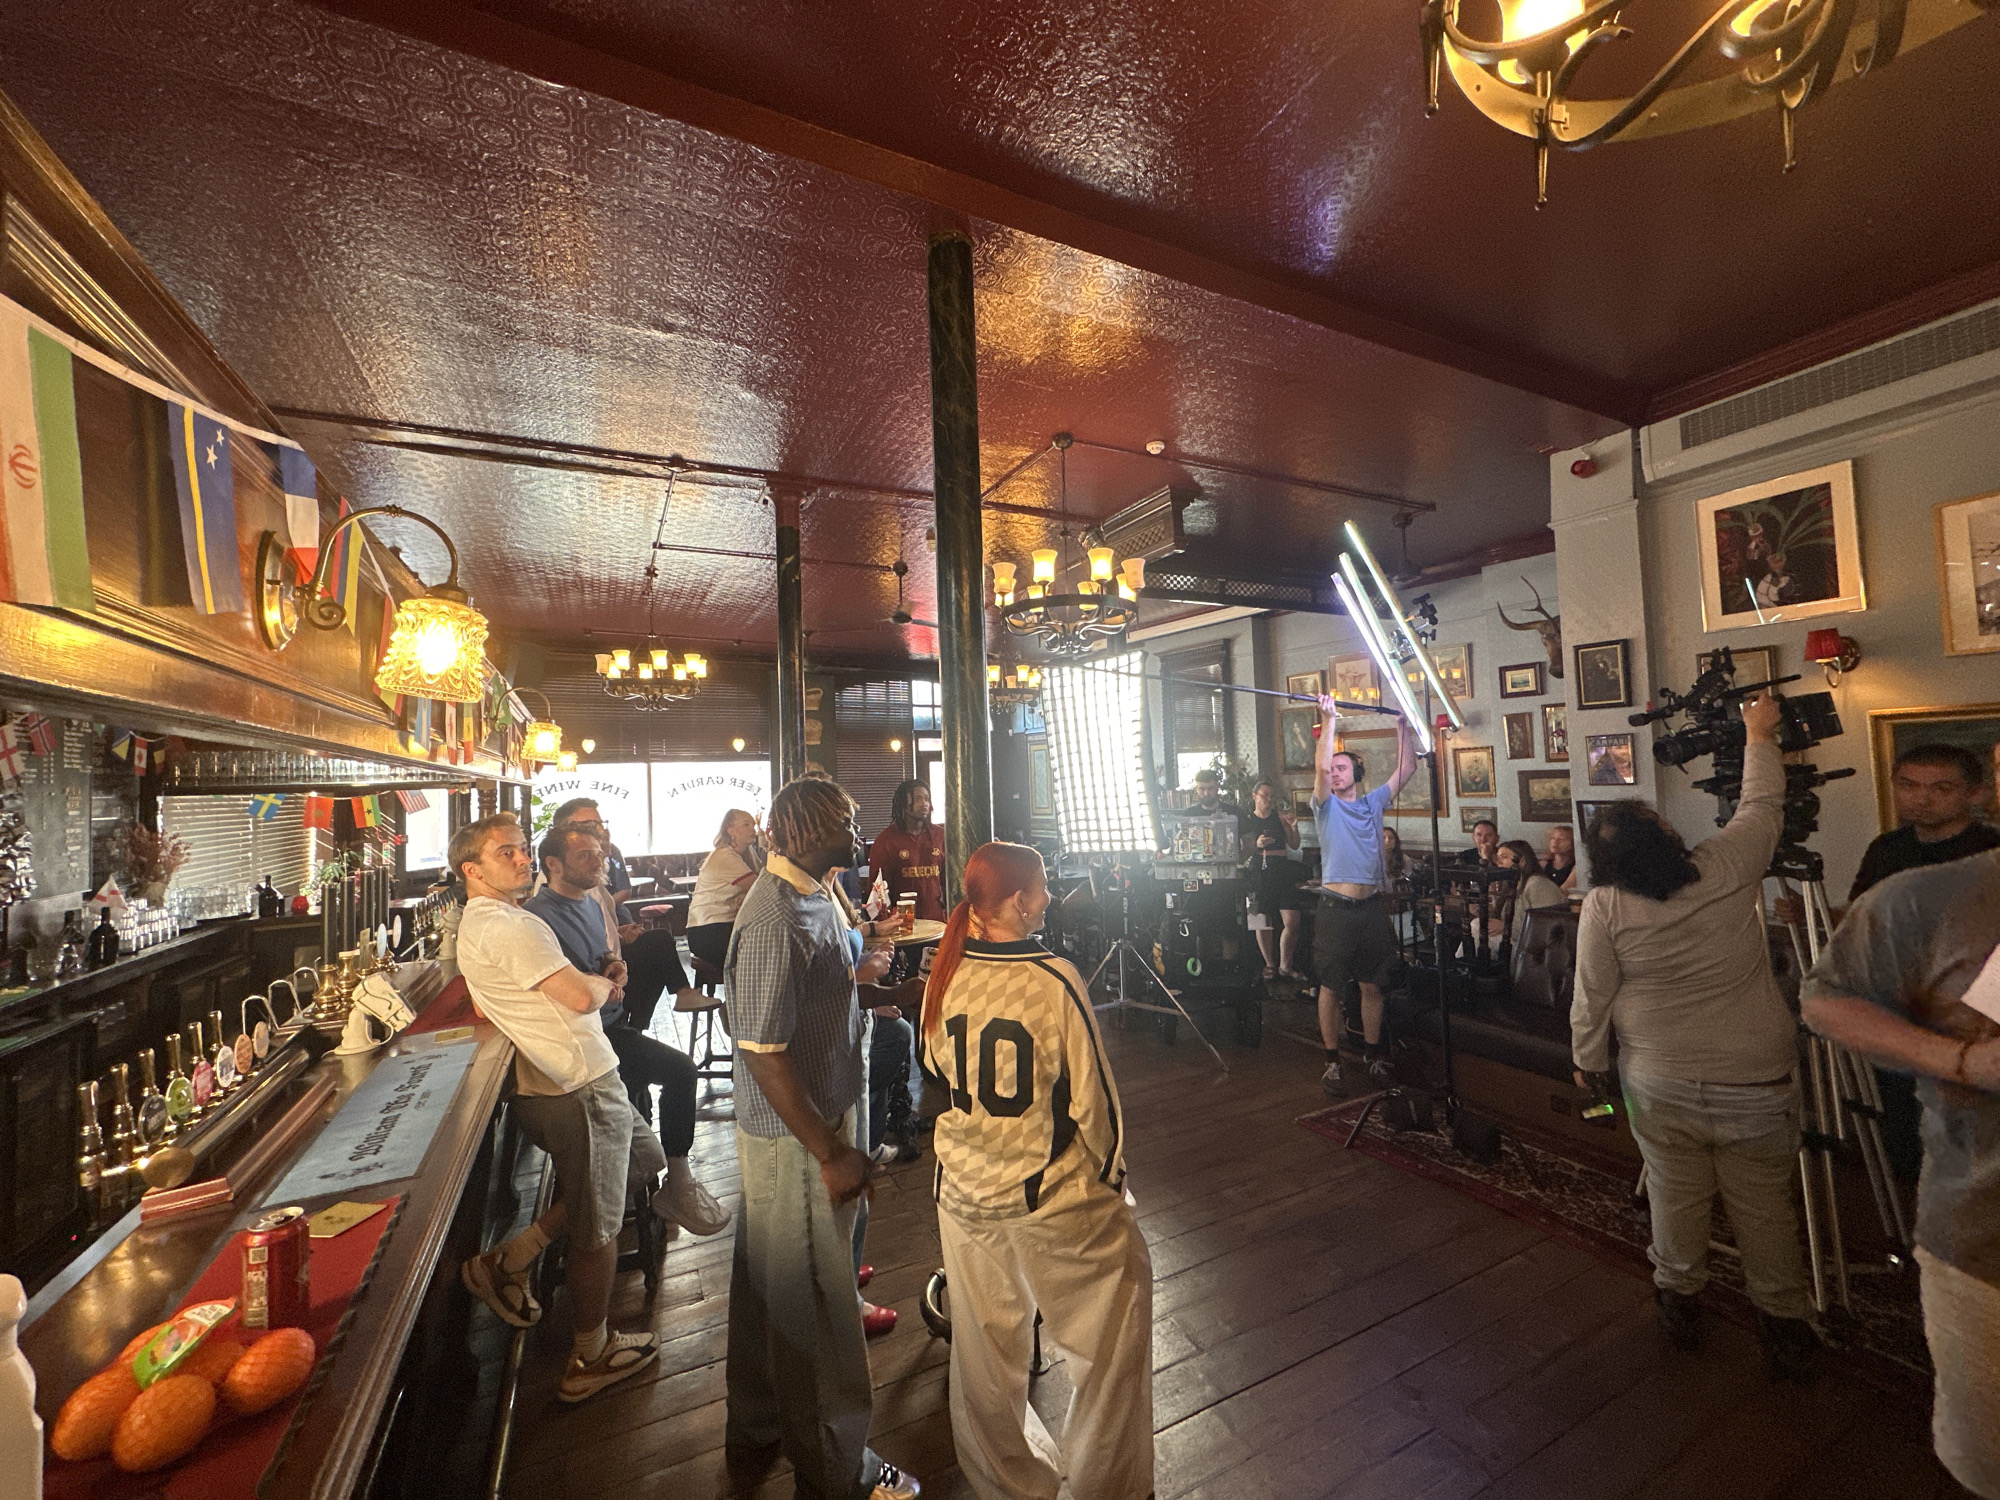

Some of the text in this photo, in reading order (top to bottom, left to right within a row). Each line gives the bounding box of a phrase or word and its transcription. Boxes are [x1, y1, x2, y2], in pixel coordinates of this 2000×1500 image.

[393, 1062, 433, 1093] Fourth
[945, 1014, 1034, 1117] 10
[379, 1092, 416, 1115] The
[348, 1113, 402, 1162] William
